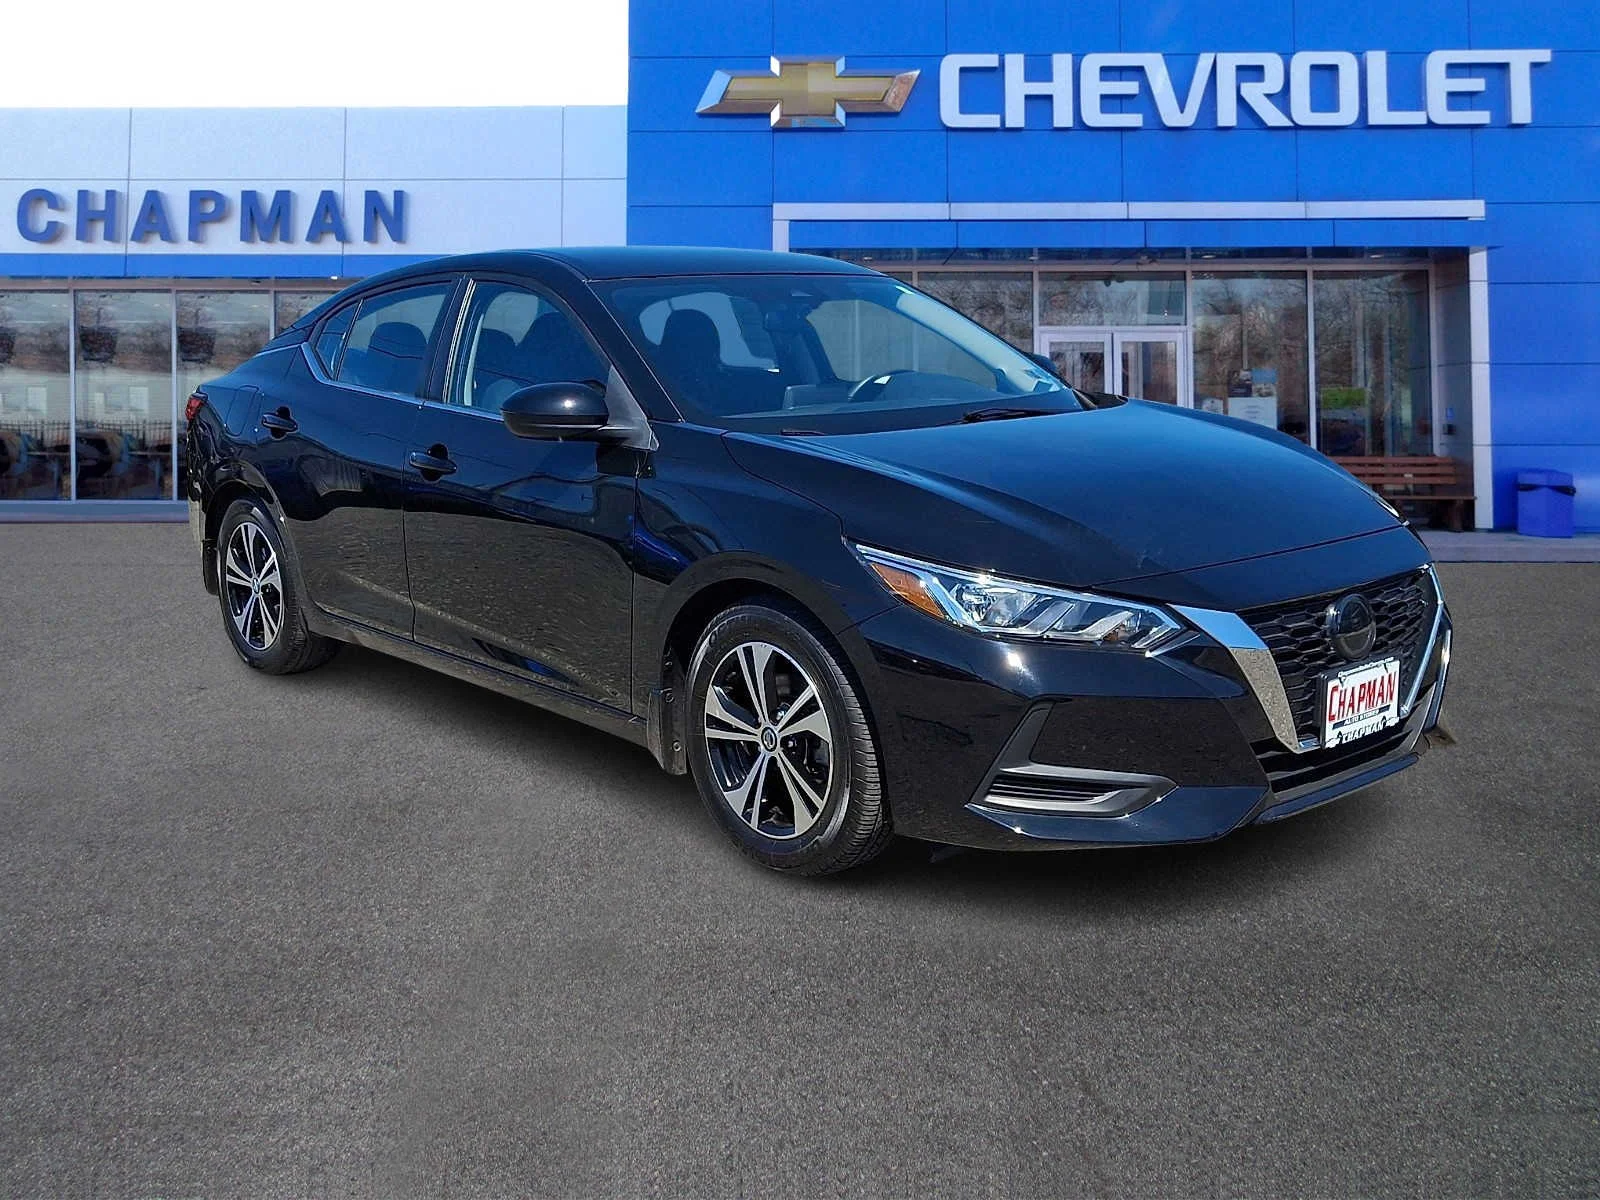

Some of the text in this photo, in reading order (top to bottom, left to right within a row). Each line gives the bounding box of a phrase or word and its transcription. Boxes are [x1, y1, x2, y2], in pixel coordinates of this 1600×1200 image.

[939, 49, 1553, 129] CHEVROLET
[16, 188, 408, 243] CHAPMAN
[1328, 672, 1396, 722] CHAPMAN
[1343, 722, 1384, 743] CHAPMAN
